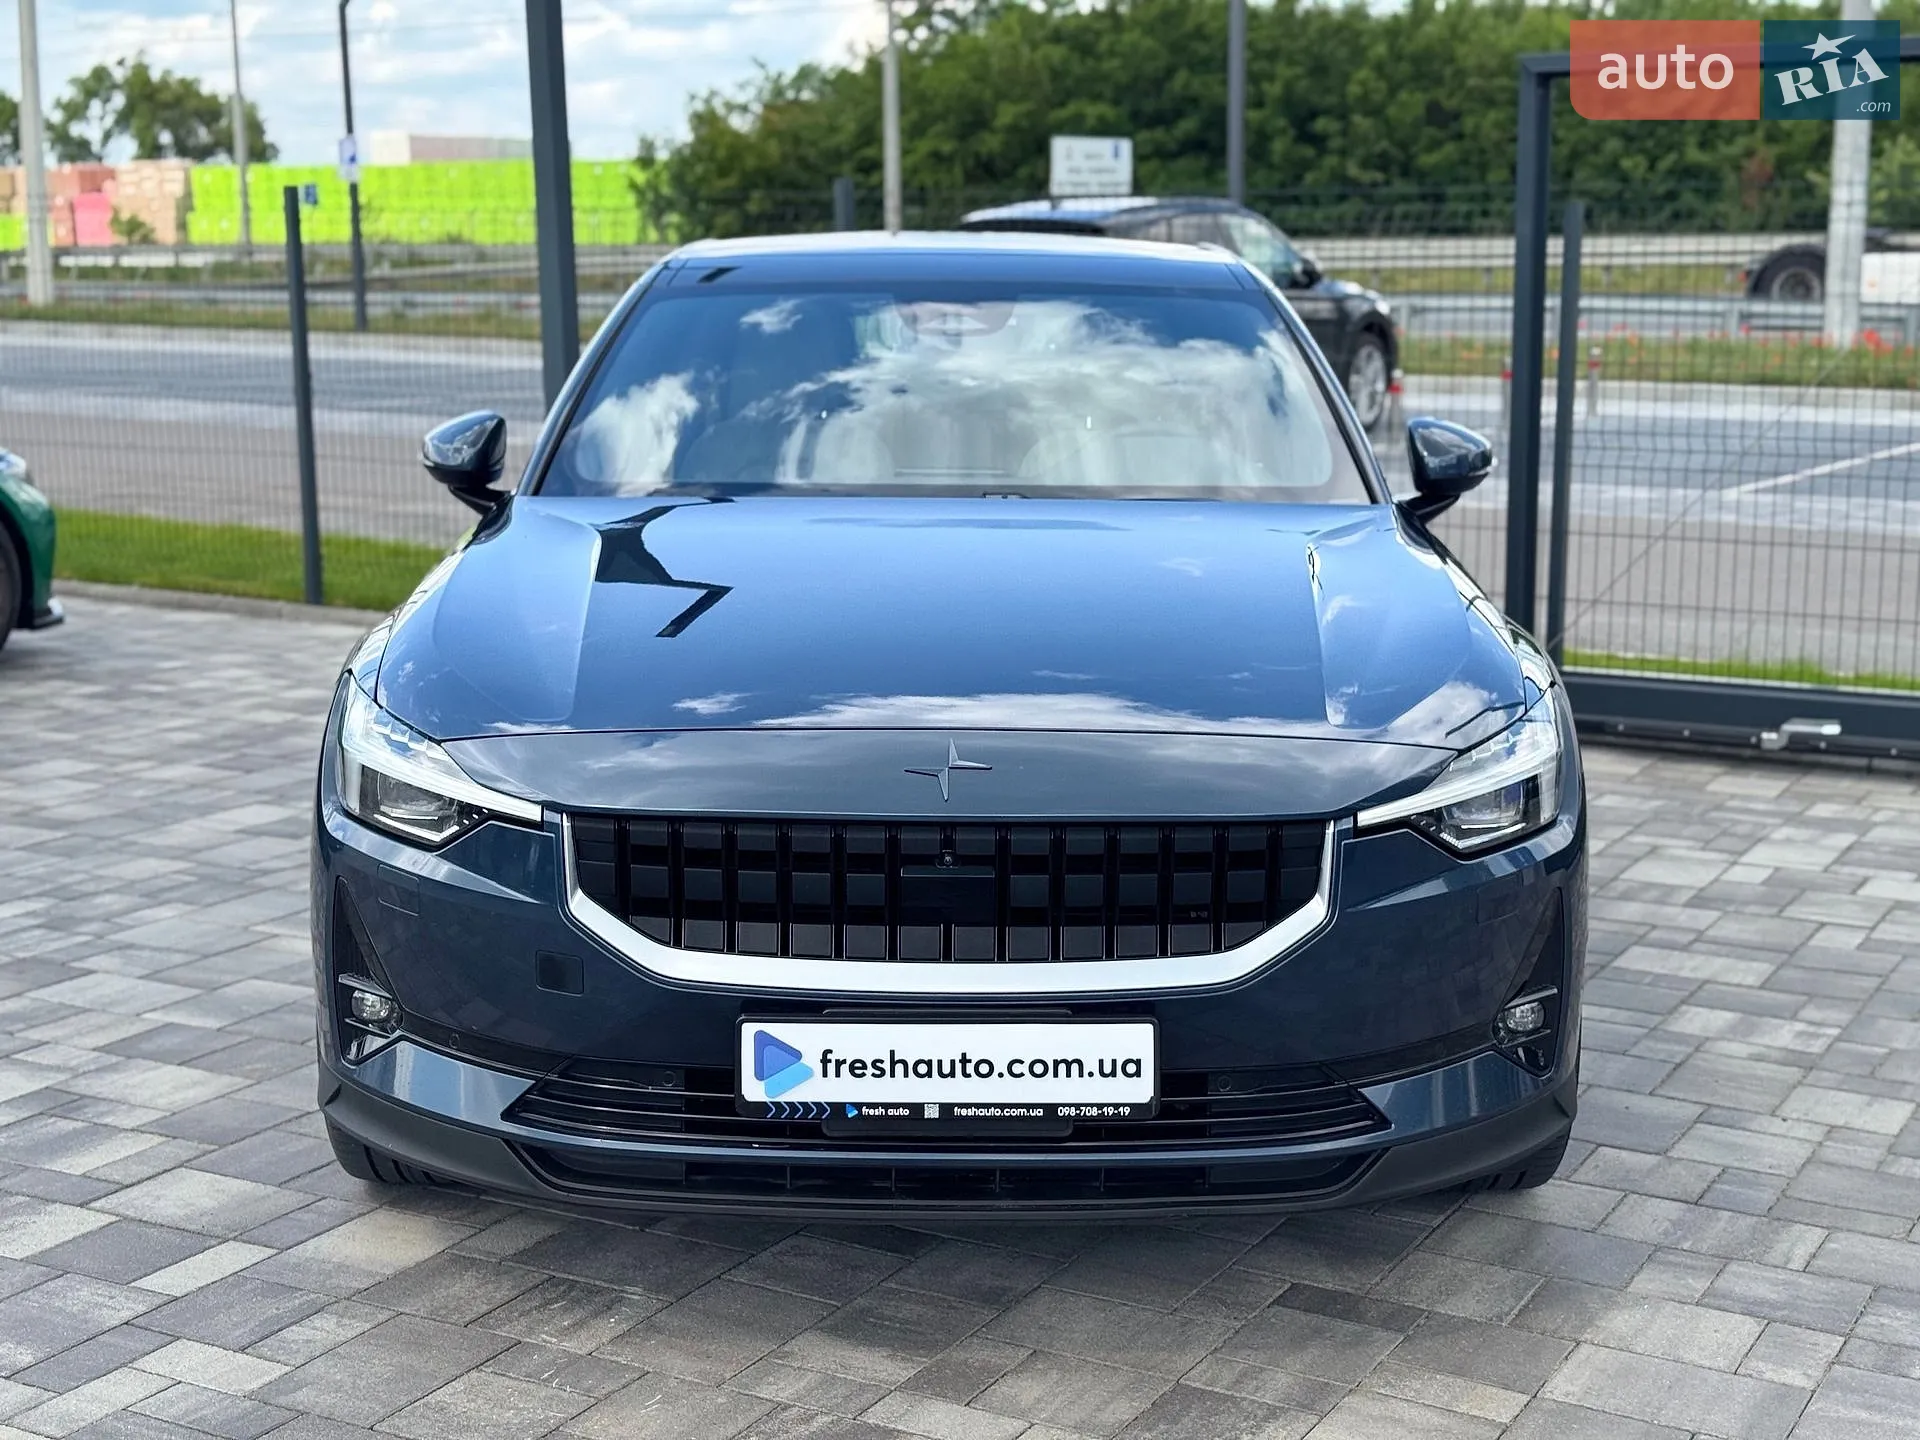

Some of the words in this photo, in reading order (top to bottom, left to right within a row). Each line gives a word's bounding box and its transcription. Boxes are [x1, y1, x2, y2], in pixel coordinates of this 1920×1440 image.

[819, 1048, 1142, 1079] freshauto.com.ua
[861, 1105, 886, 1116] fresh
[887, 1106, 910, 1116] auto
[953, 1106, 1044, 1117] freshauto.com.ua
[1057, 1106, 1131, 1117] 098-708-19-19
